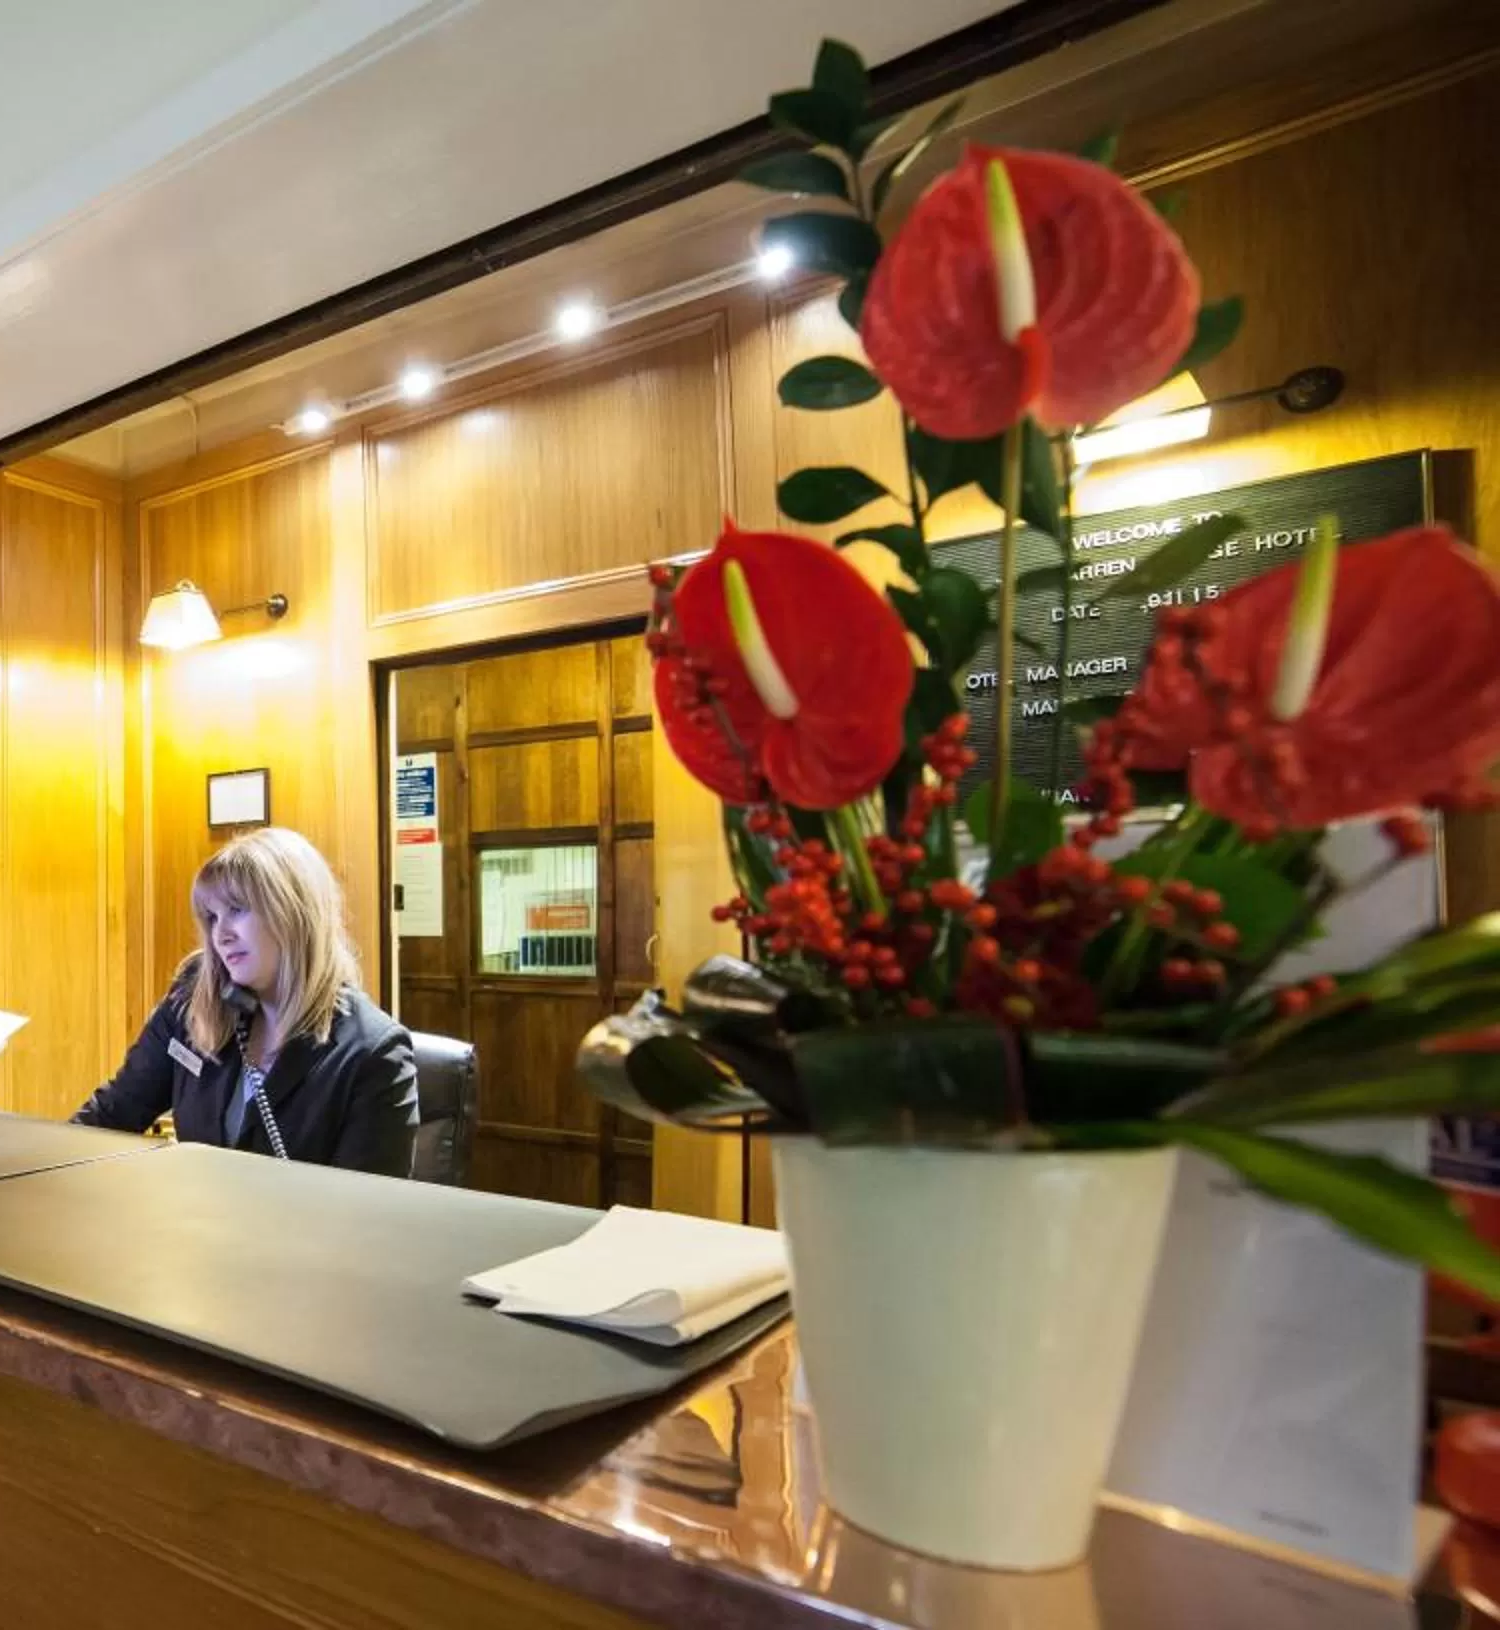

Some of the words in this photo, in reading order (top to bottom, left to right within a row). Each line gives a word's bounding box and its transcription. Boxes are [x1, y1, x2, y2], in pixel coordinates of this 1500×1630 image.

[1072, 517, 1182, 550] WELCOME
[1069, 557, 1136, 581] RREN
[1255, 527, 1343, 551] HOTE
[1026, 656, 1129, 683] MANAGER
